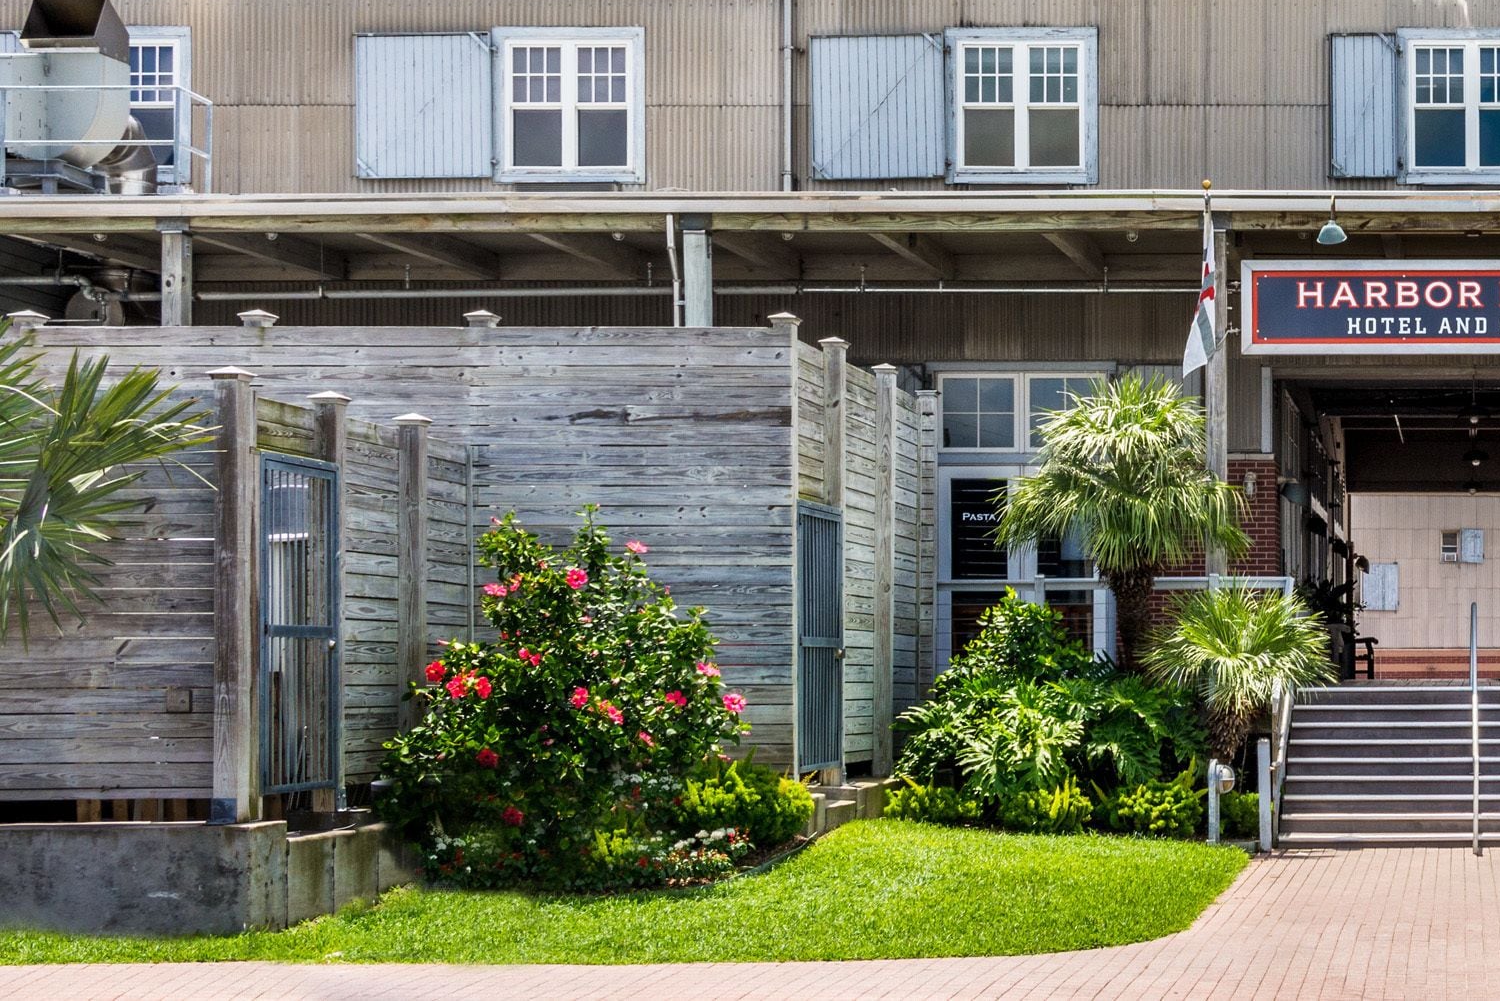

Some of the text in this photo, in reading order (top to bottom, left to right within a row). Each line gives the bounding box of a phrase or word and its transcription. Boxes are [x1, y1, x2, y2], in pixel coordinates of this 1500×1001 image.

[1296, 280, 1483, 309] HARBOR
[1347, 316, 1427, 335] HOTEL
[1438, 316, 1488, 335] AND
[962, 512, 996, 521] PASTA
